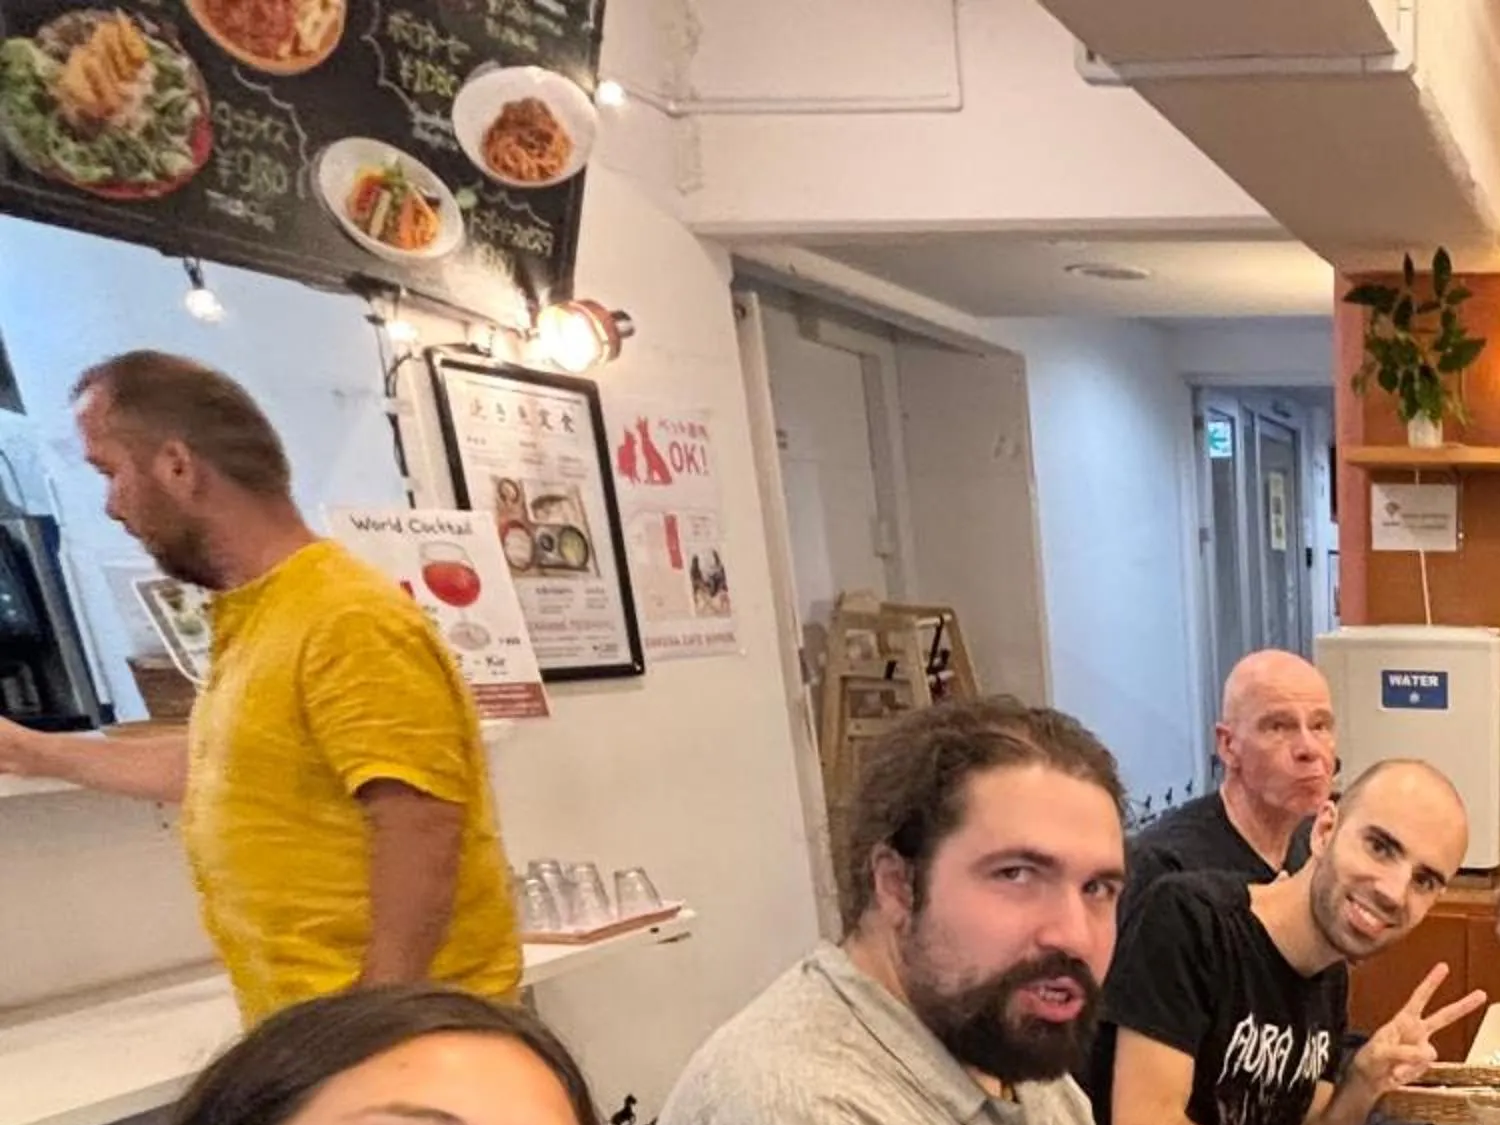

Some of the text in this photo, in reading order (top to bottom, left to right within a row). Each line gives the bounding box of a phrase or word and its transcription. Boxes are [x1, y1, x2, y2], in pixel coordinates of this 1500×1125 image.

[668, 440, 710, 476] OK!
[350, 513, 473, 535] World Cocktail
[1388, 673, 1439, 687] WATER
[1217, 1011, 1294, 1088] AURA
